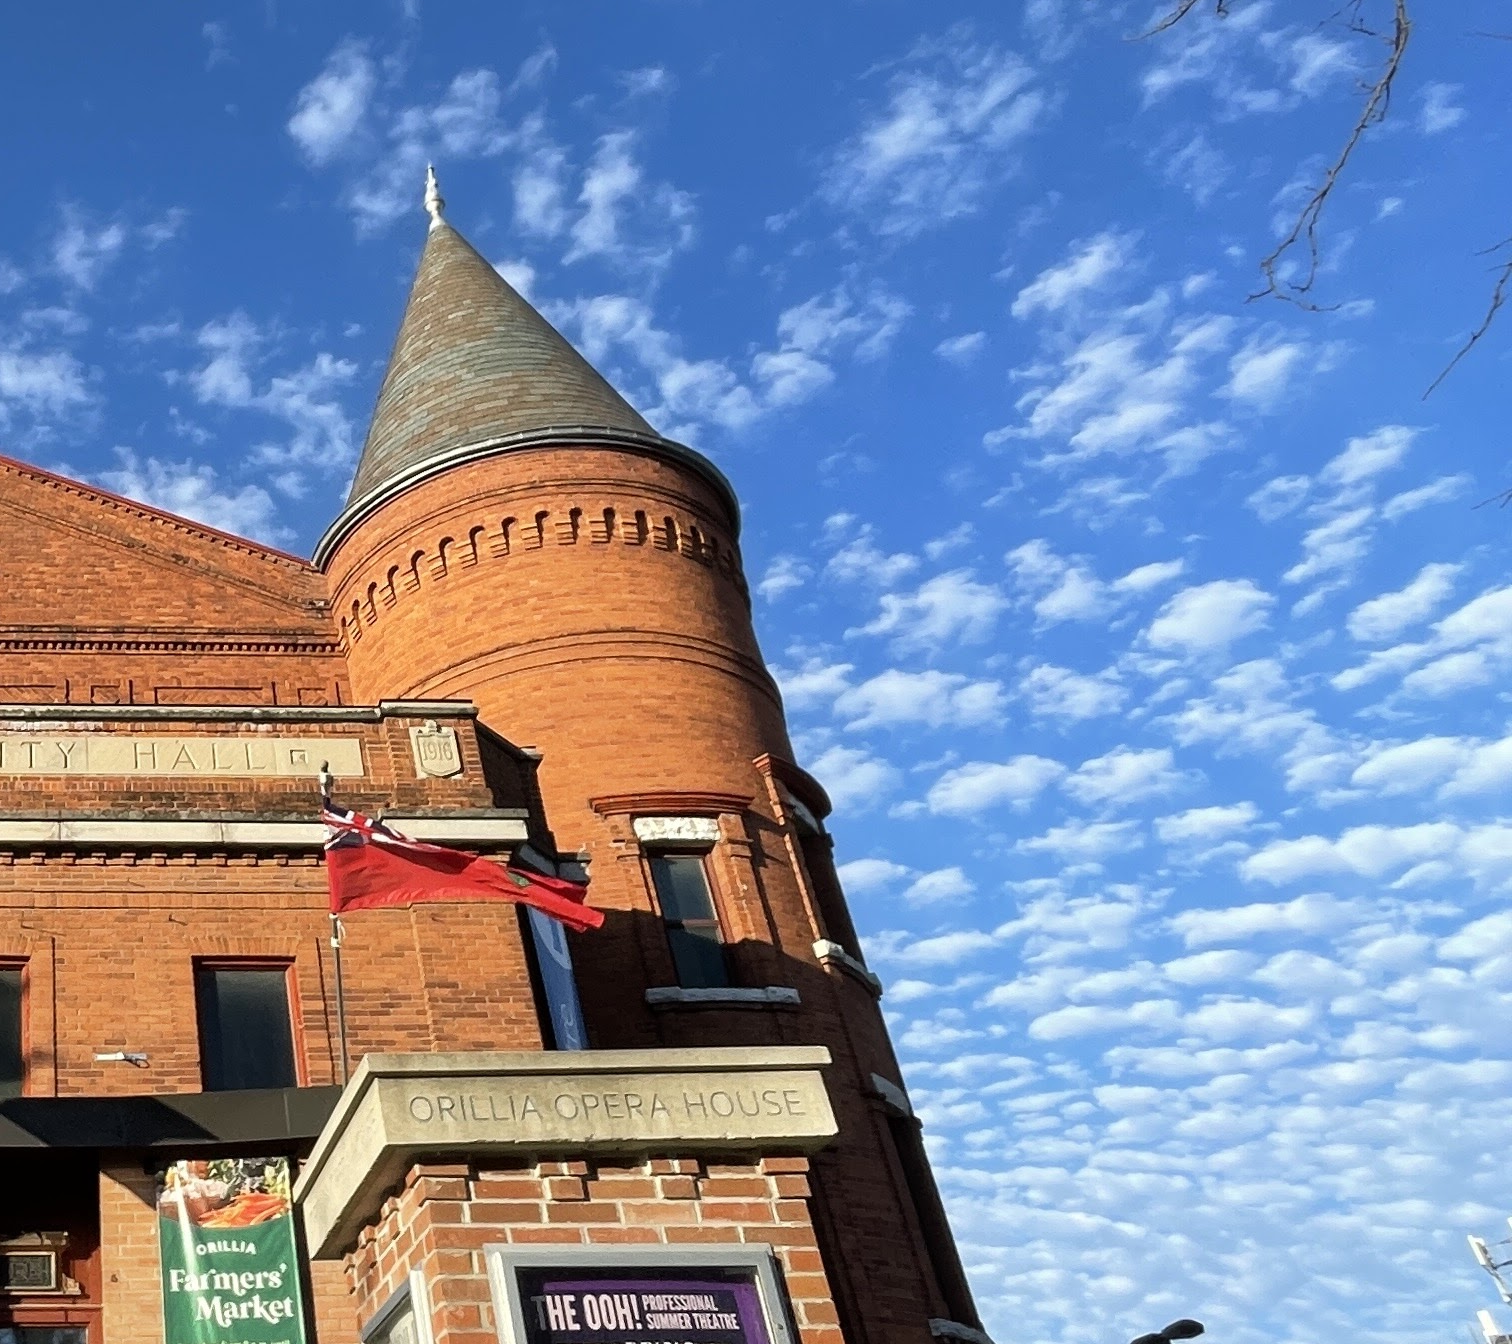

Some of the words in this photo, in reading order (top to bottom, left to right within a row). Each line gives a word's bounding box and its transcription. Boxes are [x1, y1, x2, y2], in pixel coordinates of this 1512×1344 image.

[134, 742, 268, 770] HALL
[409, 1095, 543, 1122] ORILLIA
[553, 1091, 671, 1121] OPERA
[684, 1089, 807, 1118] HOUSE
[196, 1240, 257, 1255] ORILLIA
[194, 1293, 295, 1328] Market
[583, 1294, 643, 1331] OOH!
[641, 1294, 719, 1312] PROFESSIONAL
[645, 1313, 692, 1330] SUMMER
[692, 1312, 740, 1330] THEATRE
